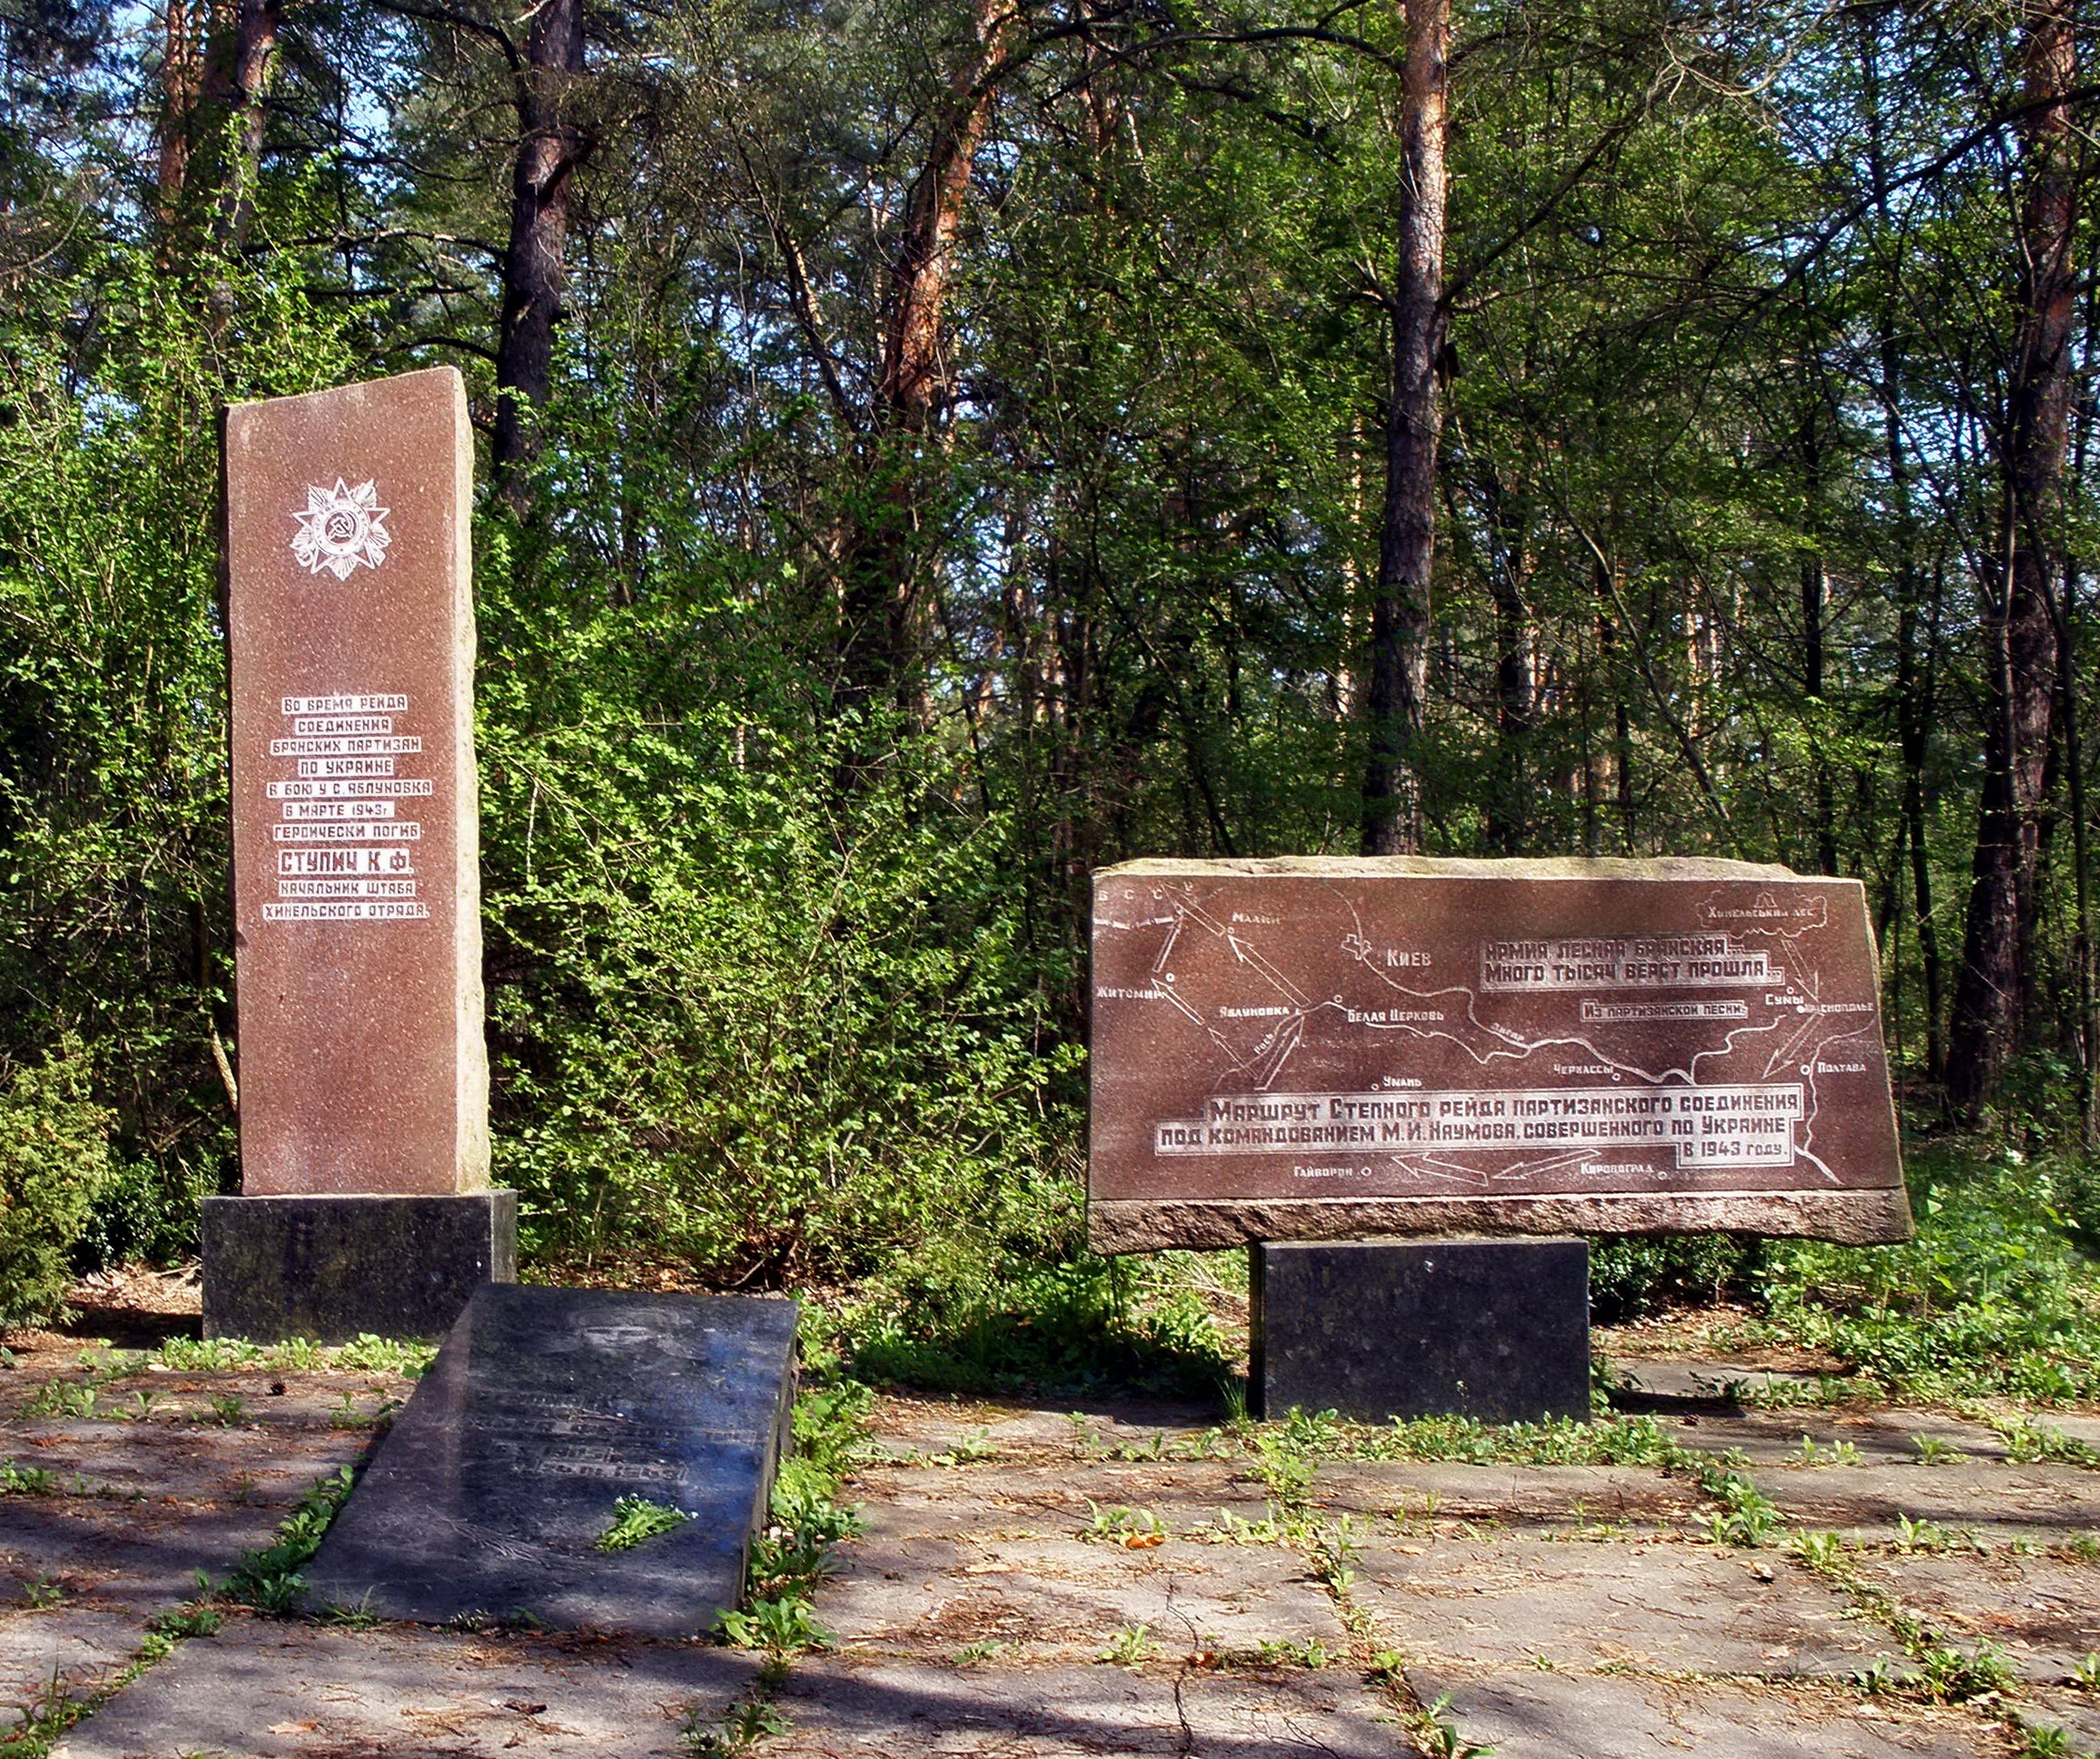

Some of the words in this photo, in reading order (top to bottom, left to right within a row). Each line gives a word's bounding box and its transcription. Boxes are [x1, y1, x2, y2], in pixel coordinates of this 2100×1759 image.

[284, 698, 301, 712] ВО
[307, 699, 353, 711] ВРЕМЯ
[298, 719, 390, 732] СОЕДИНЕНИЯ
[273, 740, 341, 753] БРЯНСКИХ
[347, 738, 420, 751] ПАРТИЗАН
[300, 761, 318, 775] ПО
[325, 760, 392, 774] УКРАИНЕ
[269, 785, 277, 796] В
[285, 784, 313, 795] БОЮ
[319, 784, 326, 795] У
[348, 781, 431, 794] ЯБЛУНОВКА
[285, 805, 293, 817] В
[299, 804, 345, 817] МАРТЕ
[274, 825, 365, 838] ГЕРОИЧЕСКИ
[373, 824, 418, 837] ПОГИБ
[281, 851, 357, 872] СТУПИЧ
[281, 882, 360, 894] НАЧАЛЬНИК
[366, 882, 413, 894] ШТАБА
[265, 906, 361, 918] ХИНЕЛЬСКОГО
[1557, 940, 1625, 959] ЛЕСНАЯ
[1485, 962, 1545, 982] МНОГО
[1553, 963, 1616, 982] ТЫСЯЧ
[1625, 962, 1681, 979] ВЕРСТ
[1210, 1101, 1321, 1121] МАРШРУТ
[1330, 1098, 1431, 1120] СТЕПНОГО
[1440, 1097, 1505, 1118] РЕЙДА
[1513, 1095, 1673, 1116] ПАРТИЗАНСКОГО
[1679, 1094, 1799, 1113] СОЕДИНЕНИЯ
[1161, 1128, 1202, 1146] ПОД
[1208, 1125, 1375, 1145] КОМАНДОВАНИЕМ
[1523, 1120, 1664, 1140] СОВЕРШЕННОГО
[1671, 1118, 1694, 1136] ПО
[1701, 1116, 1787, 1135] УКРАИНЕ
[1683, 1142, 1694, 1157] В
[1701, 1141, 1741, 1157] 1943
